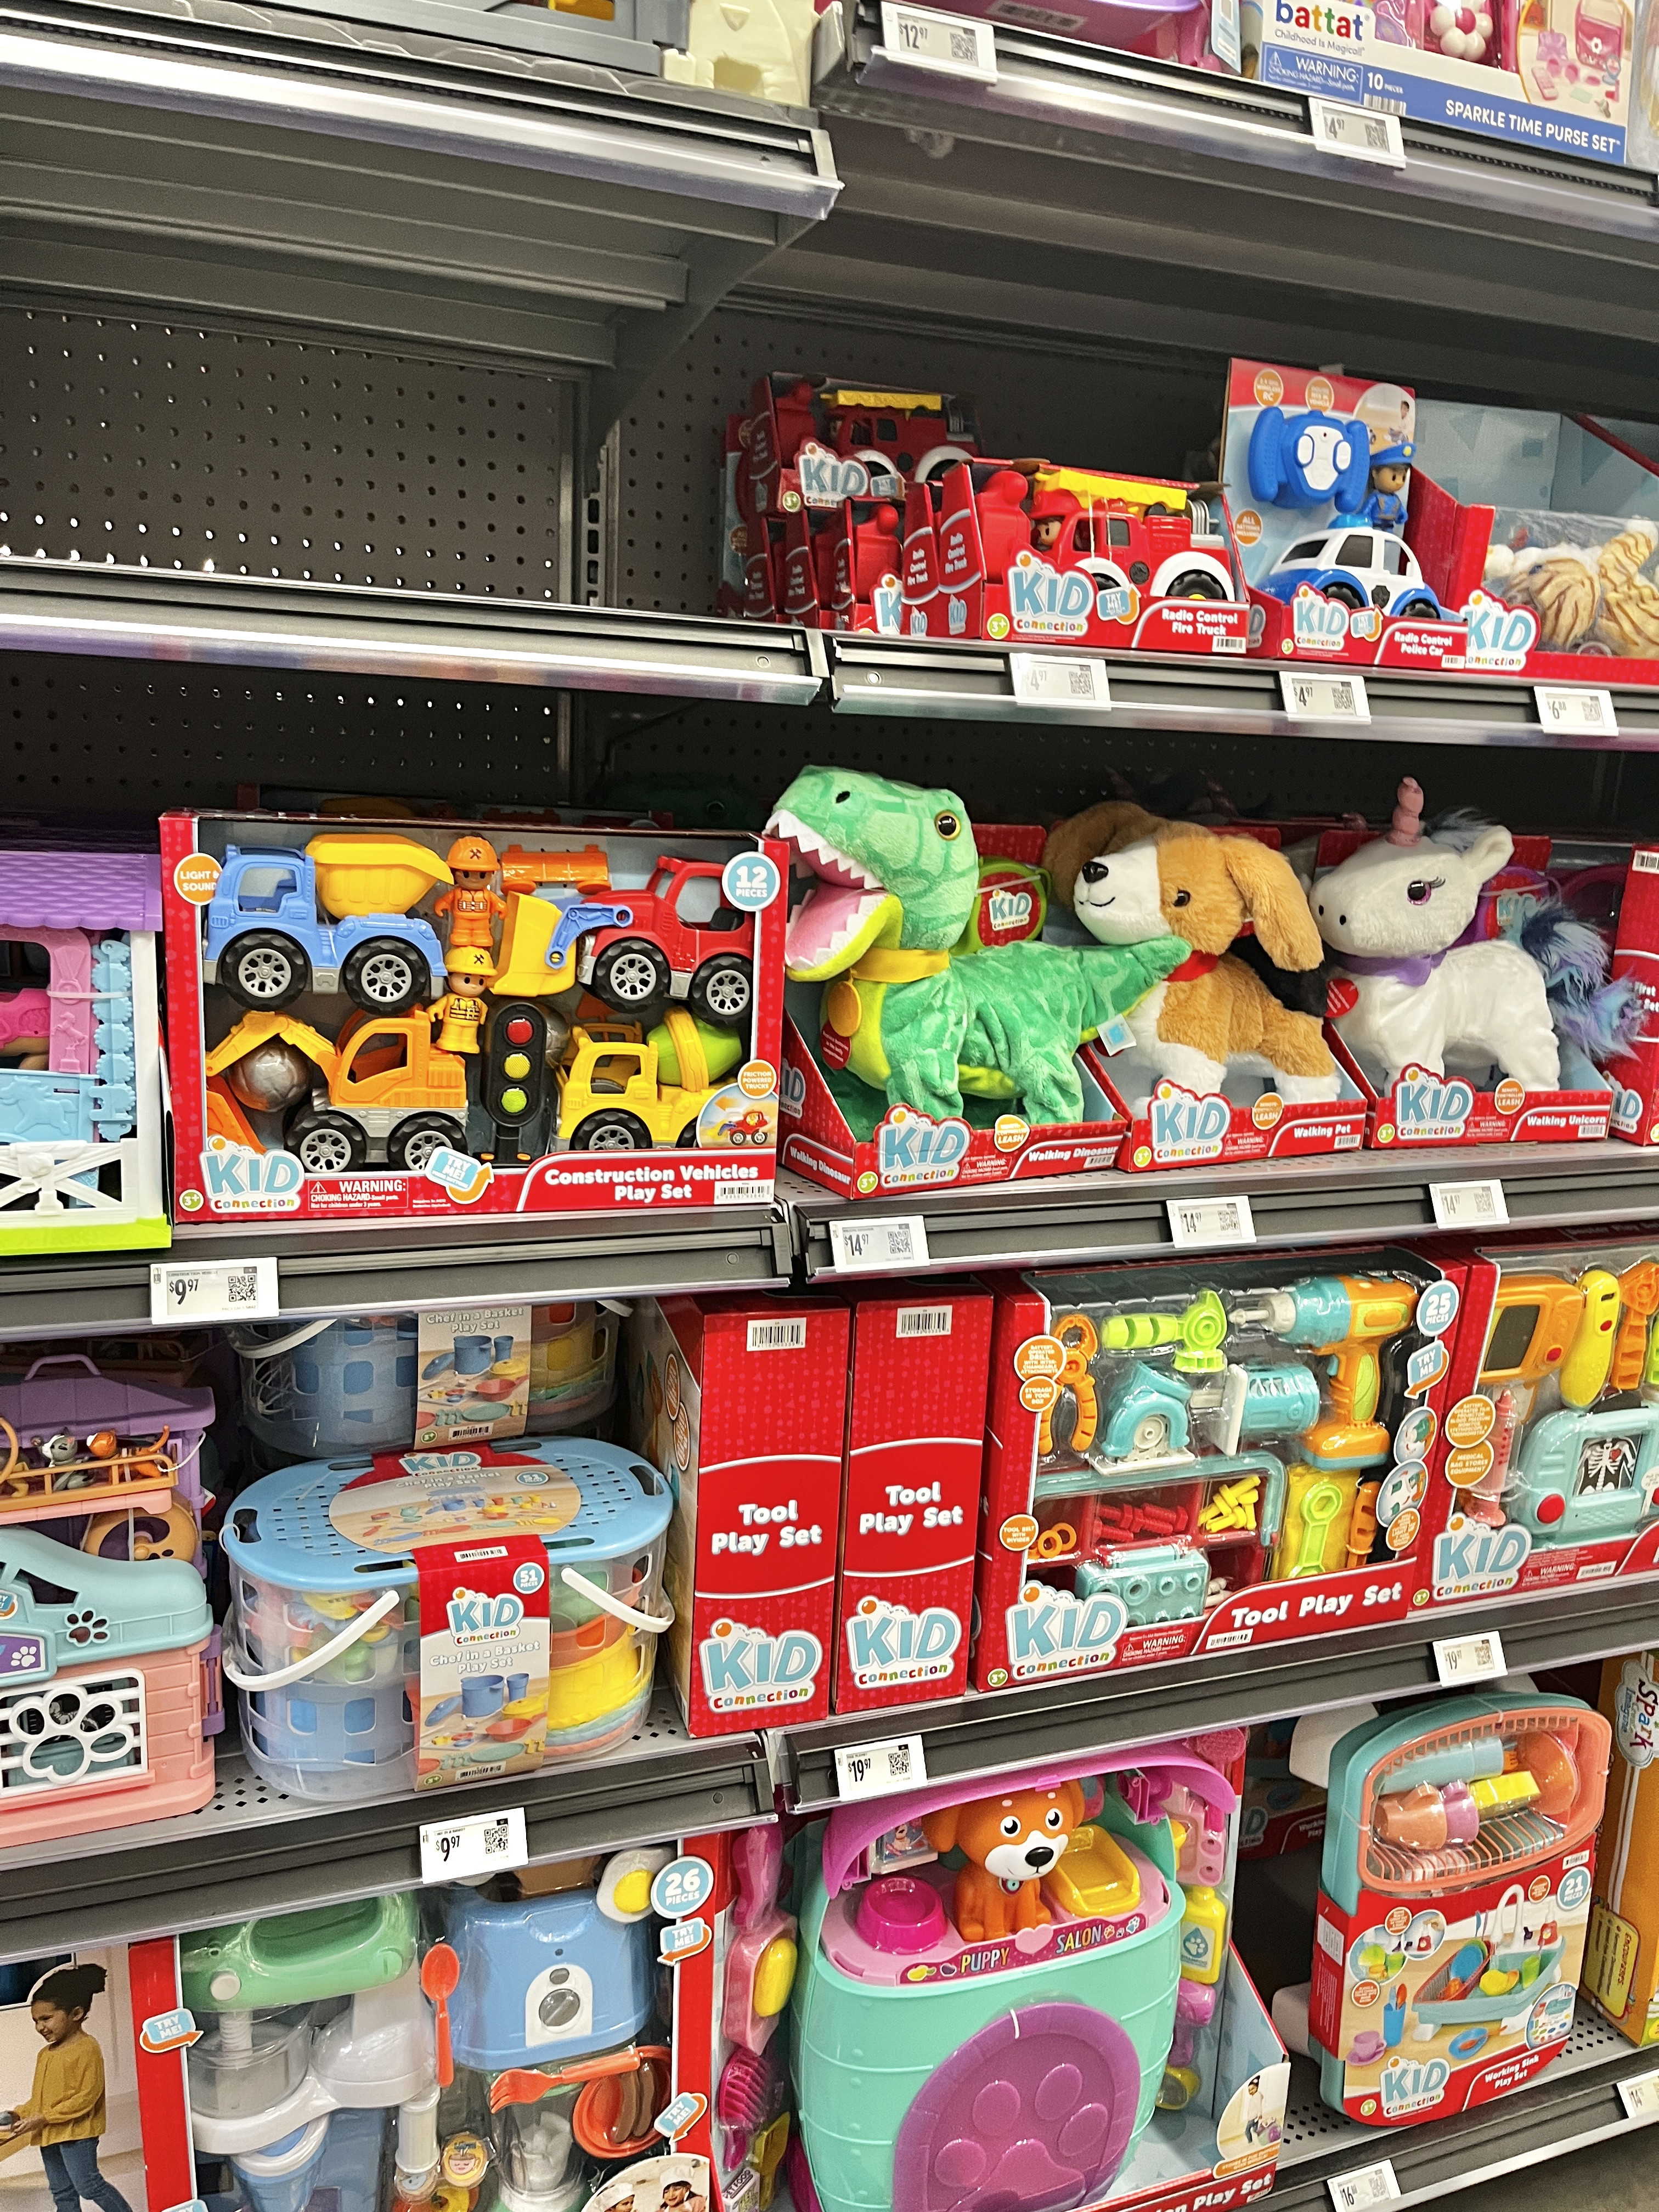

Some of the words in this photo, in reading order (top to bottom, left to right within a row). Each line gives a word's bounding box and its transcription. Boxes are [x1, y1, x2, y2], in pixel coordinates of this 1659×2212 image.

[1276, 0, 1363, 41] battat
[1275, 29, 1317, 46] Childhood
[1318, 39, 1326, 47] Is
[1295, 56, 1360, 83] WARNING:
[1368, 72, 1384, 90] 10
[1446, 100, 1506, 128] SPARKLE
[1509, 114, 1543, 137] TIME
[1545, 125, 1589, 148] PURSE
[803, 459, 865, 494] KID
[1012, 571, 1090, 618] KID
[1017, 618, 1084, 633] Connection
[1163, 609, 1187, 621] Radio
[1193, 611, 1238, 624] Control
[1297, 601, 1346, 635] KID
[991, 621, 1007, 633] 3+
[1172, 623, 1193, 634] Fire
[1197, 624, 1226, 636] Truck
[1465, 609, 1532, 652] KID
[1297, 637, 1341, 647] Connection
[1395, 631, 1418, 643] Radio
[1420, 635, 1453, 647] Control
[1401, 644, 1426, 655] Police
[1428, 645, 1444, 657] Car
[1466, 656, 1521, 666] onnection
[180, 871, 211, 879] LIGHT
[736, 865, 768, 888] 12
[182, 882, 217, 891] SOUND
[736, 888, 768, 898] PIECES
[991, 894, 1029, 920] KID
[1400, 1083, 1470, 1124] KID
[1156, 1102, 1226, 1144] KID
[1255, 1111, 1278, 1121] LEASH
[1527, 1114, 1566, 1127] Walking
[1568, 1114, 1606, 1124] Unicorn
[997, 1133, 1024, 1144] LEASH
[1294, 1125, 1334, 1138] Walking
[1336, 1125, 1351, 1134] Pet
[1380, 1129, 1393, 1140] 3+
[1400, 1125, 1461, 1136] Connection
[883, 1126, 966, 1168] KID
[1029, 1149, 1071, 1162] Walking
[1074, 1146, 1119, 1158] Dinosaur
[1137, 1150, 1149, 1162] 3+
[1157, 1144, 1218, 1158] Connection
[448, 1154, 471, 1172] TRY
[790, 1146, 817, 1171] Walking
[819, 1158, 851, 1185] Dinosaur
[206, 1154, 300, 1194] KID
[442, 1164, 466, 1181] ME!
[544, 1166, 676, 1185] Construction
[680, 1164, 758, 1180] Vehicles
[884, 1170, 954, 1184] Connection
[339, 1180, 406, 1193] WARNING:
[860, 1176, 876, 1188] 3+
[184, 1195, 200, 1206] 3+
[311, 1194, 342, 1202] CHOKING
[614, 1185, 655, 1203] Play
[660, 1184, 692, 1199] Set
[214, 1198, 295, 1208] Connection
[1427, 1291, 1452, 1316] 25
[426, 1312, 456, 1324] Chef
[459, 1313, 470, 1321] in
[484, 1307, 524, 1318] Basket
[1425, 1312, 1450, 1325] PIECES
[451, 1323, 477, 1333] Play
[479, 1320, 500, 1330] Set
[1417, 1352, 1437, 1367] TRY
[405, 1453, 477, 1472] KID
[1457, 1453, 1484, 1461] MEDICAL
[415, 1466, 478, 1477] Connection
[1450, 1466, 1486, 1475] EQUIPMENT
[886, 1482, 941, 1506] Tool
[738, 1500, 798, 1525] Tool
[859, 1512, 912, 1536] Play
[923, 1504, 963, 1527] Set
[711, 1532, 769, 1556] Play
[779, 1523, 822, 1547] Set
[1437, 1530, 1528, 1582] KID
[520, 1569, 538, 1583] 51
[1436, 1576, 1513, 1598] Connection
[450, 1597, 521, 1633] KID
[1231, 1603, 1288, 1629] Tool
[1297, 1594, 1348, 1620] Play
[1361, 1584, 1402, 1605] Set
[456, 1629, 516, 1645] Connection
[1012, 1598, 1123, 1660] KID
[851, 1613, 958, 1668] KID
[1143, 1634, 1186, 1649] WARNING:
[430, 1651, 462, 1667] Chef
[466, 1649, 479, 1661] in
[483, 1649, 491, 1658] a
[495, 1640, 540, 1657] Basket
[458, 1661, 487, 1675] Play
[490, 1657, 514, 1669] Set
[704, 1635, 819, 1692] KID
[1016, 1652, 1110, 1676] Connection
[858, 1664, 947, 1685] Connection
[991, 1672, 1007, 1684] 3+
[713, 1686, 809, 1708] Connection
[1630, 1678, 1658, 1750] Spark
[665, 1870, 701, 1895] 26
[1564, 1878, 1584, 1895] 21
[665, 1889, 700, 1906] PIECES
[1563, 1891, 1583, 1903] PIECES
[672, 1924, 694, 1940] TRY
[674, 1934, 694, 1949] ME!
[960, 1946, 1011, 1973] PUPPY
[1055, 1923, 1102, 1955] SALON
[154, 2015, 179, 2030] TRY
[160, 2024, 182, 2039] ME!
[1485, 2065, 1520, 2083] Working
[1522, 2055, 1539, 2069] Sink
[1384, 2063, 1447, 2104] KID
[1494, 2075, 1513, 2090] Play
[1514, 2068, 1528, 2081] Set
[667, 2100, 686, 2121] TRY
[1386, 2094, 1441, 2115] Connection
[673, 2107, 691, 2128] ME!
[1193, 2188, 1236, 2211] Play
[1240, 2173, 1272, 2195] Set
